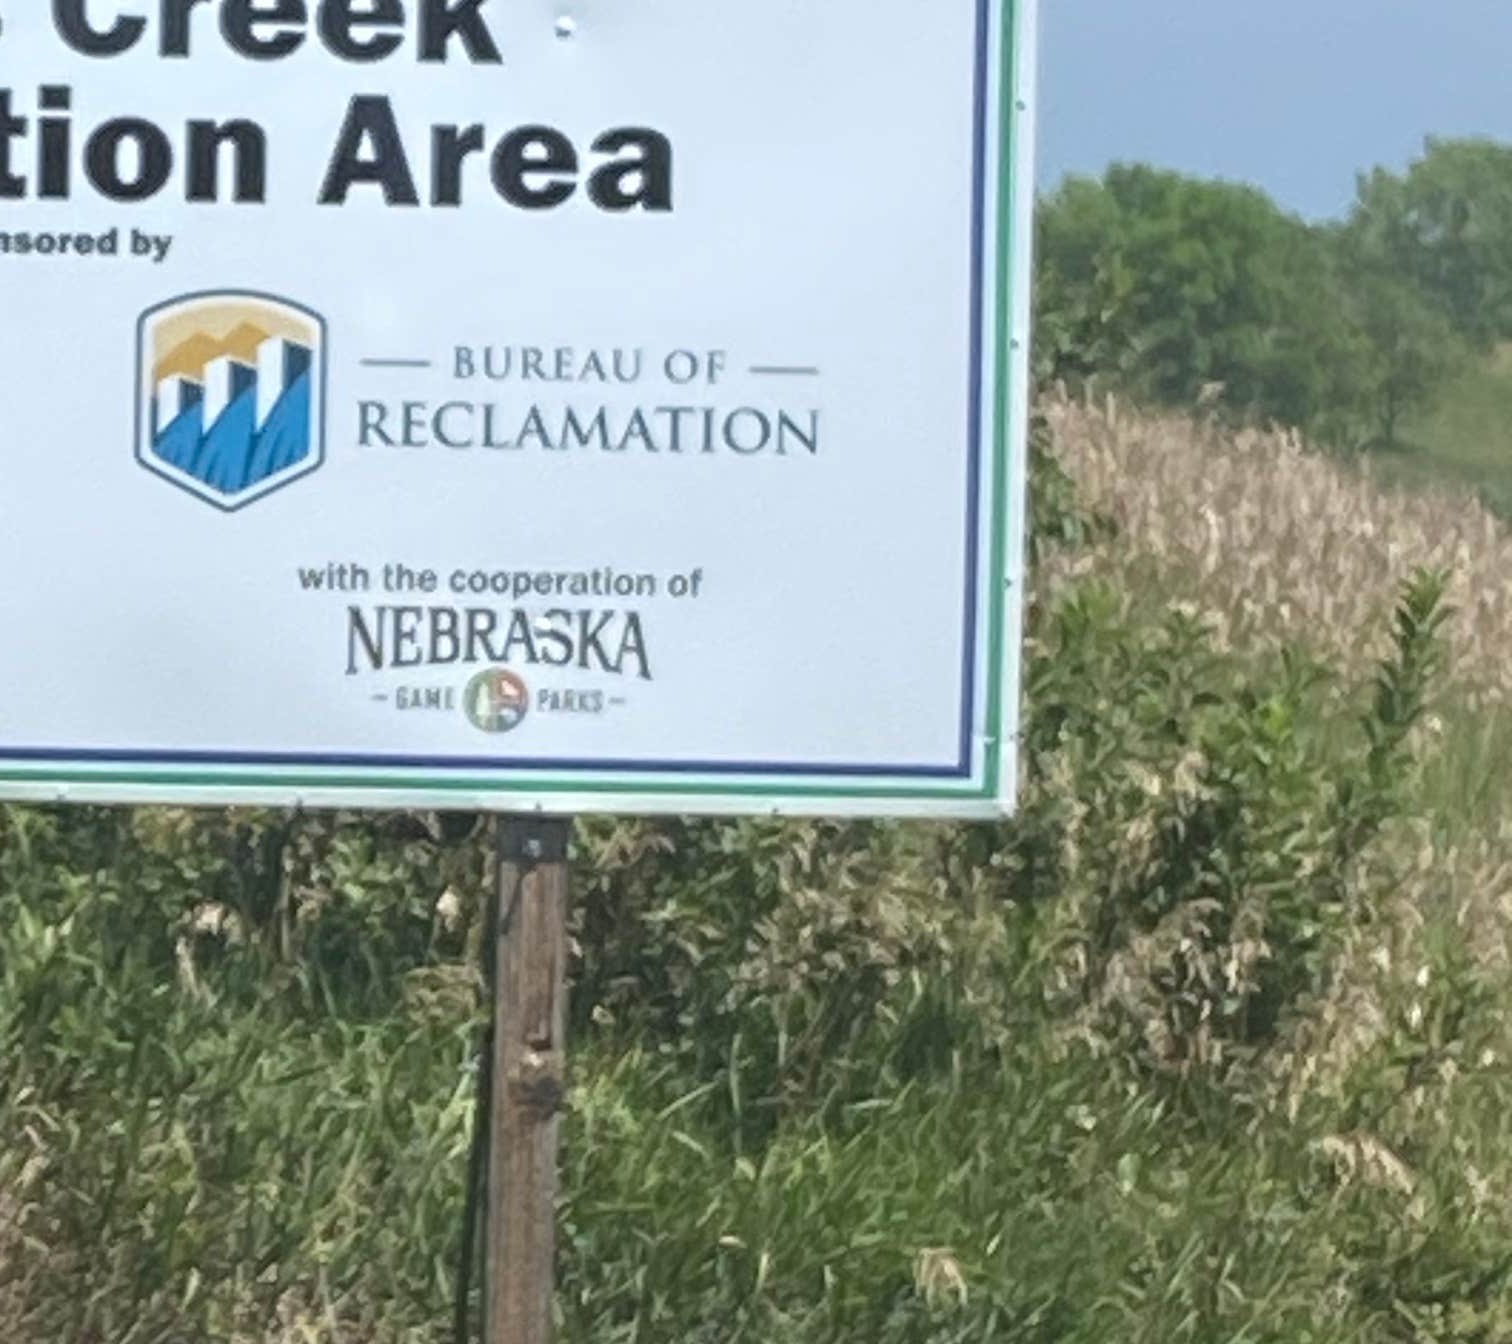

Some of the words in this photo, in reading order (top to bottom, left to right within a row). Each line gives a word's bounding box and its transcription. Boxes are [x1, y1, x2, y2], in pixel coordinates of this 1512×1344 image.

[316, 94, 674, 213] Area
[130, 228, 173, 264] by
[453, 345, 641, 383] BUREAU
[663, 349, 724, 385] OF
[358, 400, 818, 456] RECLAMATION
[297, 562, 370, 591] with
[383, 563, 438, 593] the
[449, 566, 657, 601] cooperation
[667, 567, 703, 598] of
[345, 605, 653, 680] NEBRASKA
[537, 688, 603, 715] PARKS
